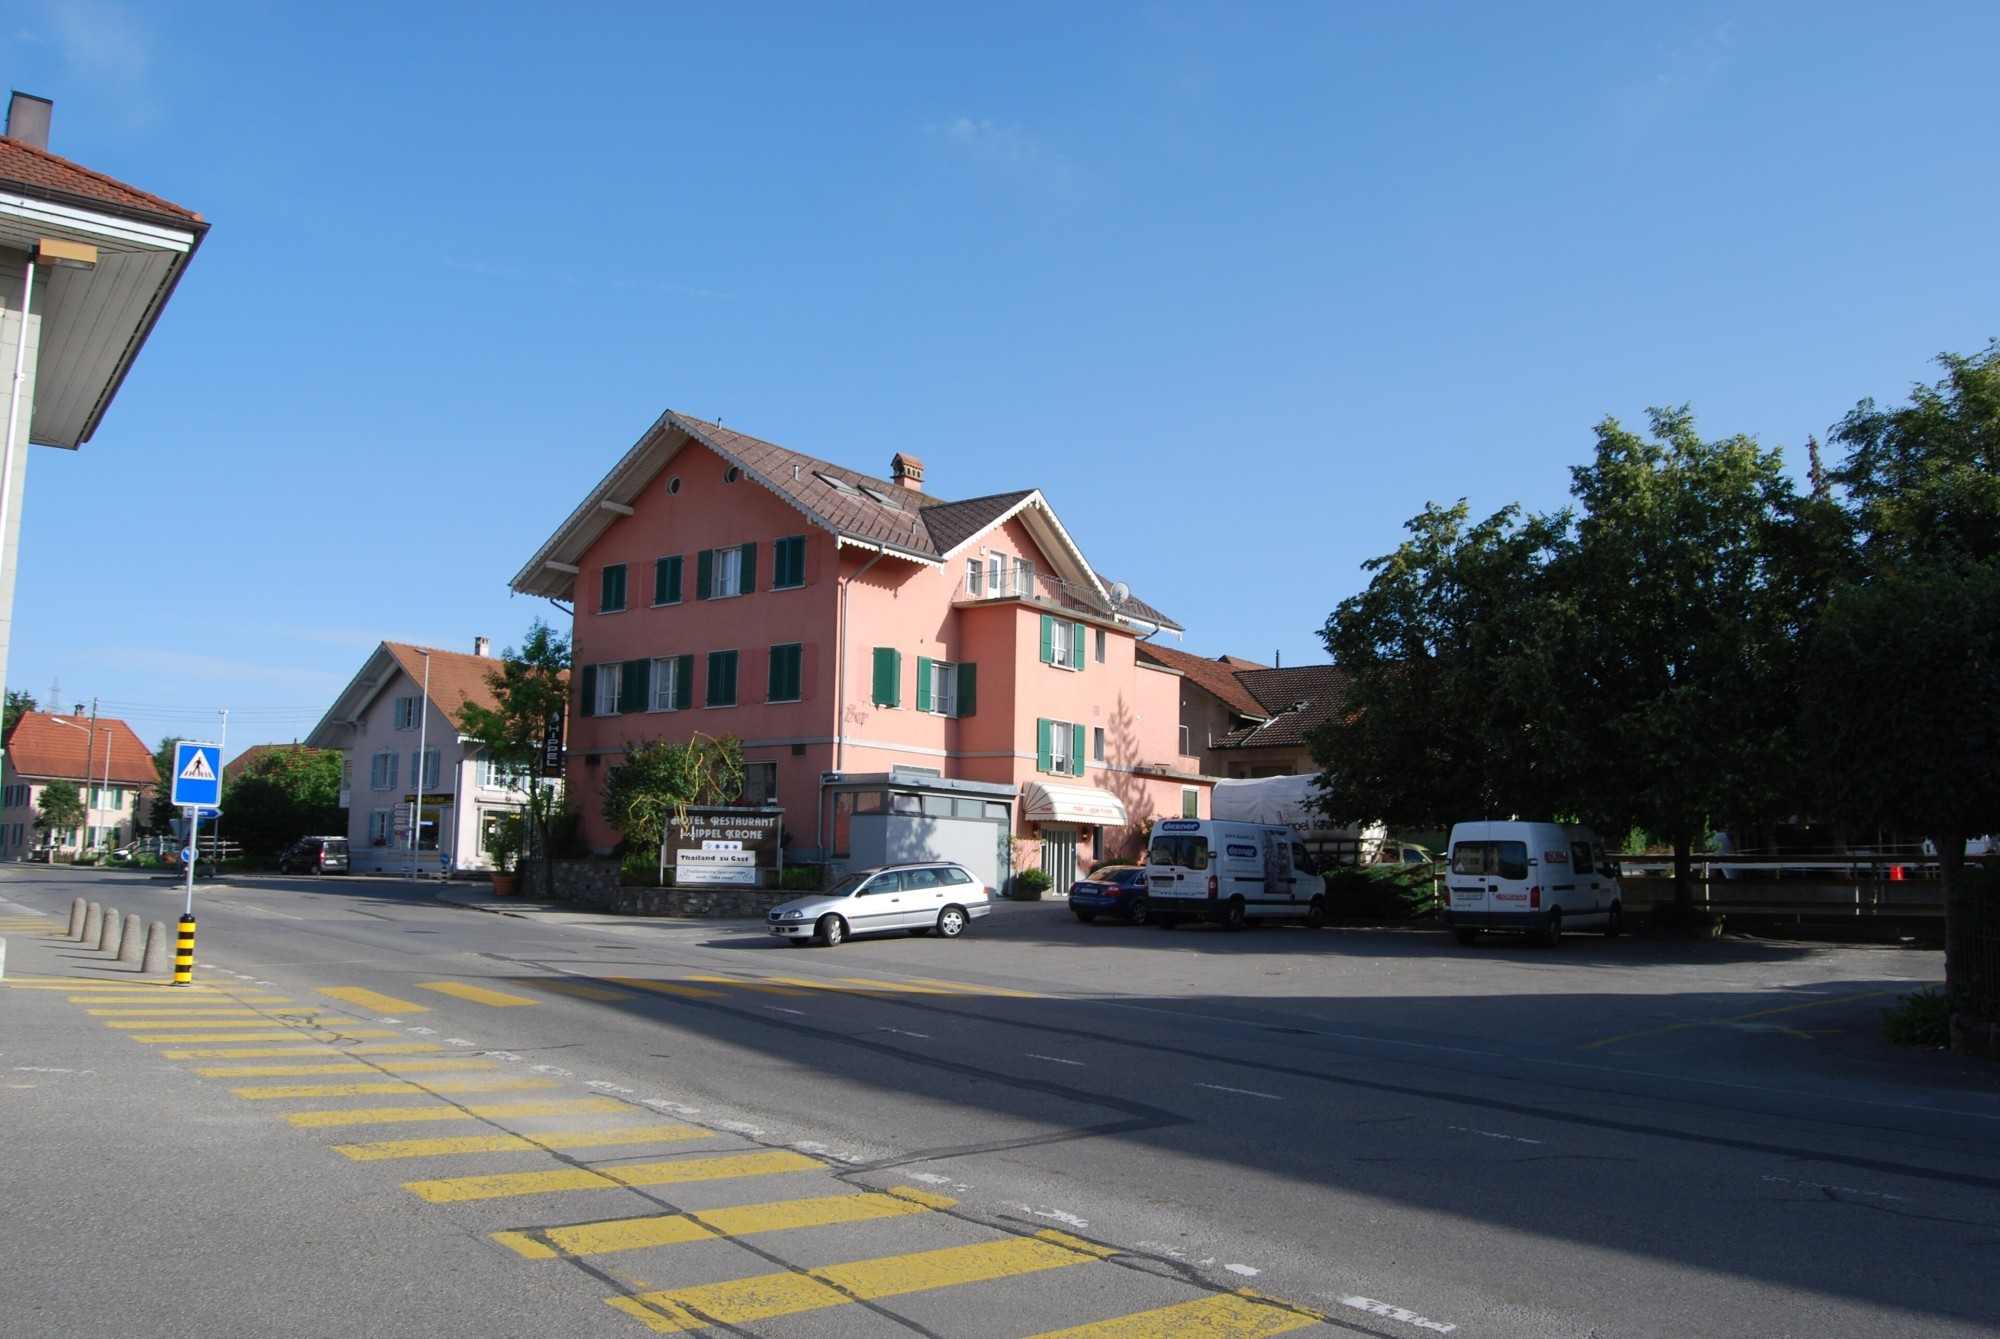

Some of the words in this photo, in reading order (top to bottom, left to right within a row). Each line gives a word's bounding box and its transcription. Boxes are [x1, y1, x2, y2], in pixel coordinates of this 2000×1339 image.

[546, 725, 560, 767] HIPPEL
[710, 816, 775, 827] RESTAURANT
[725, 829, 763, 840] KRONE
